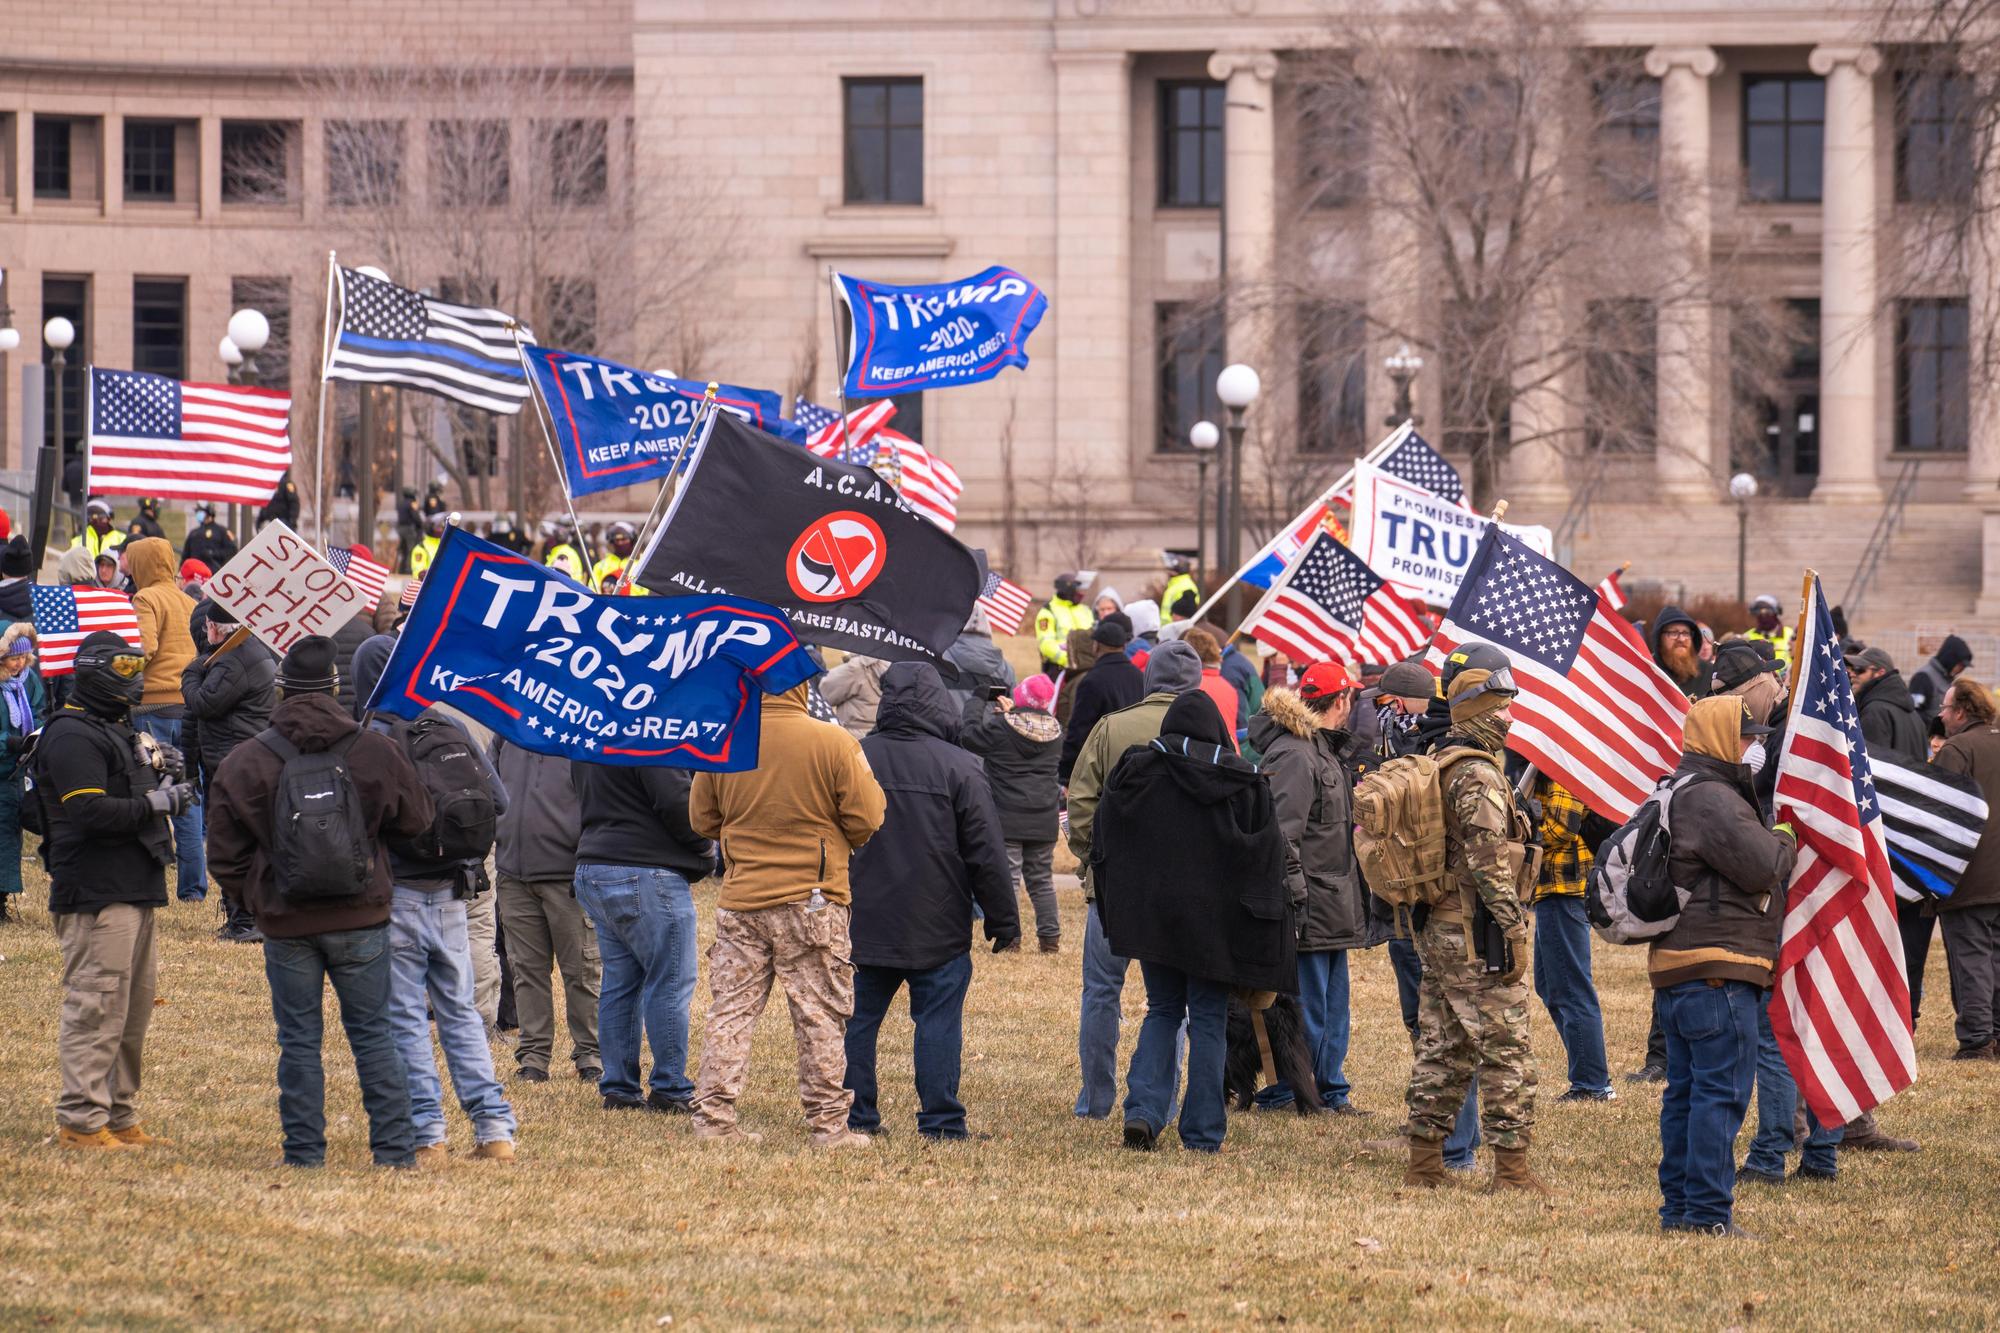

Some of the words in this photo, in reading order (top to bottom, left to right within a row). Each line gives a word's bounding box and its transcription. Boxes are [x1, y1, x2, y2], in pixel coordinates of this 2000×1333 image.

[919, 316, 980, 352] -2020-
[871, 366, 914, 380] KEEP
[915, 350, 978, 375] AMERICA
[588, 443, 629, 463] KEEP
[635, 434, 698, 454] AMERIC
[1381, 511, 1469, 568] TRU
[1394, 494, 1475, 529] PROMISES
[243, 553, 331, 635] THE
[266, 535, 355, 603] STOP
[1392, 557, 1464, 587] PROMISE
[210, 573, 302, 655] STEAL
[480, 570, 771, 679] TRUMP
[671, 572, 708, 593] ALL
[792, 610, 833, 629] ARE
[501, 668, 618, 736] AMERICA
[622, 716, 727, 742] GREAT!
